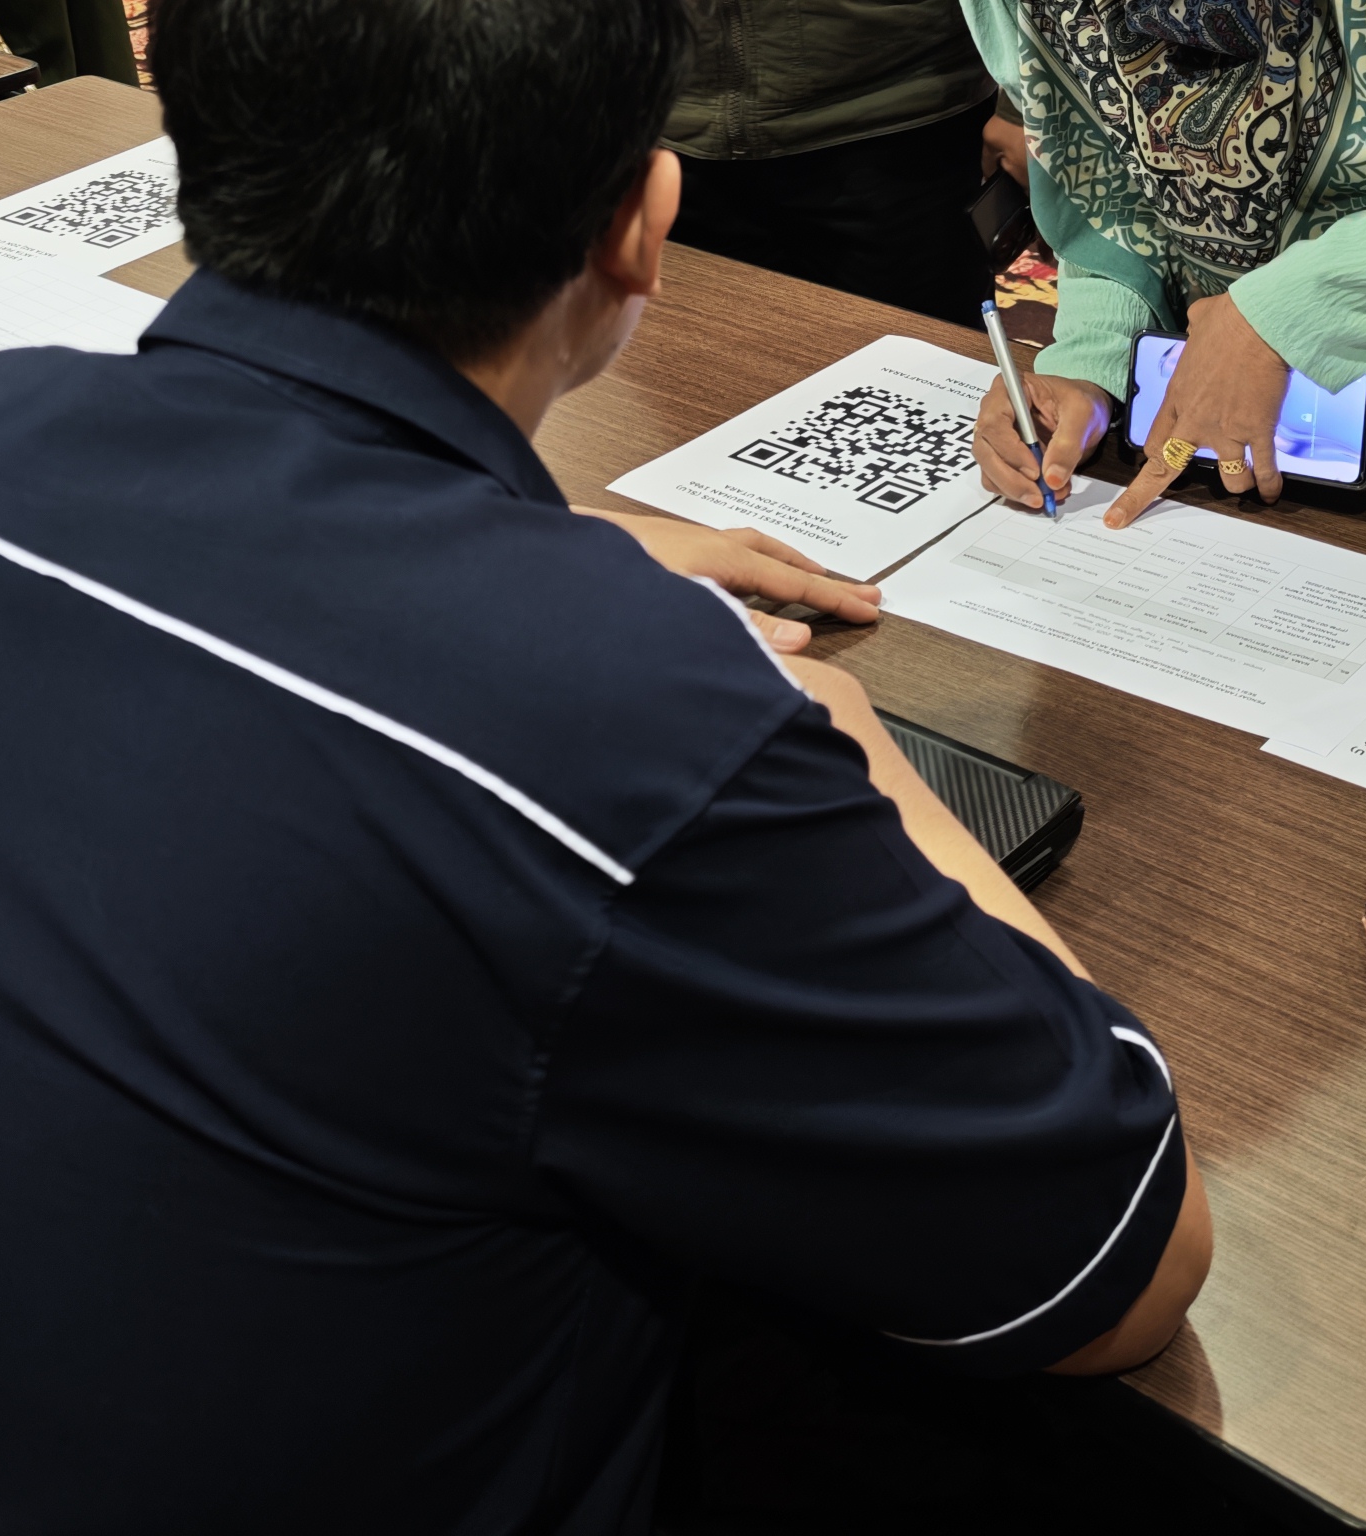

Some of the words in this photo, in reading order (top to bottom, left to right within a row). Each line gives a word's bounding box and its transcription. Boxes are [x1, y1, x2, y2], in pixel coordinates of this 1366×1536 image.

[879, 366, 947, 389] PENDAFTARAN
[945, 387, 983, 401] UNTUK
[673, 484, 703, 496] (SLU)
[686, 480, 710, 490] 1966
[721, 484, 756, 498] UTARA
[699, 494, 729, 506] URUS
[708, 488, 774, 513] PERTUBUHAN
[754, 495, 779, 506] ZON
[727, 504, 759, 517] LIBAT
[776, 503, 801, 513] 832]
[757, 514, 783, 525] SESI
[772, 510, 801, 522] AKTA
[798, 510, 832, 524] [AKTA
[780, 522, 843, 547] KEHADIRAN
[799, 520, 849, 539] PINDAAN
